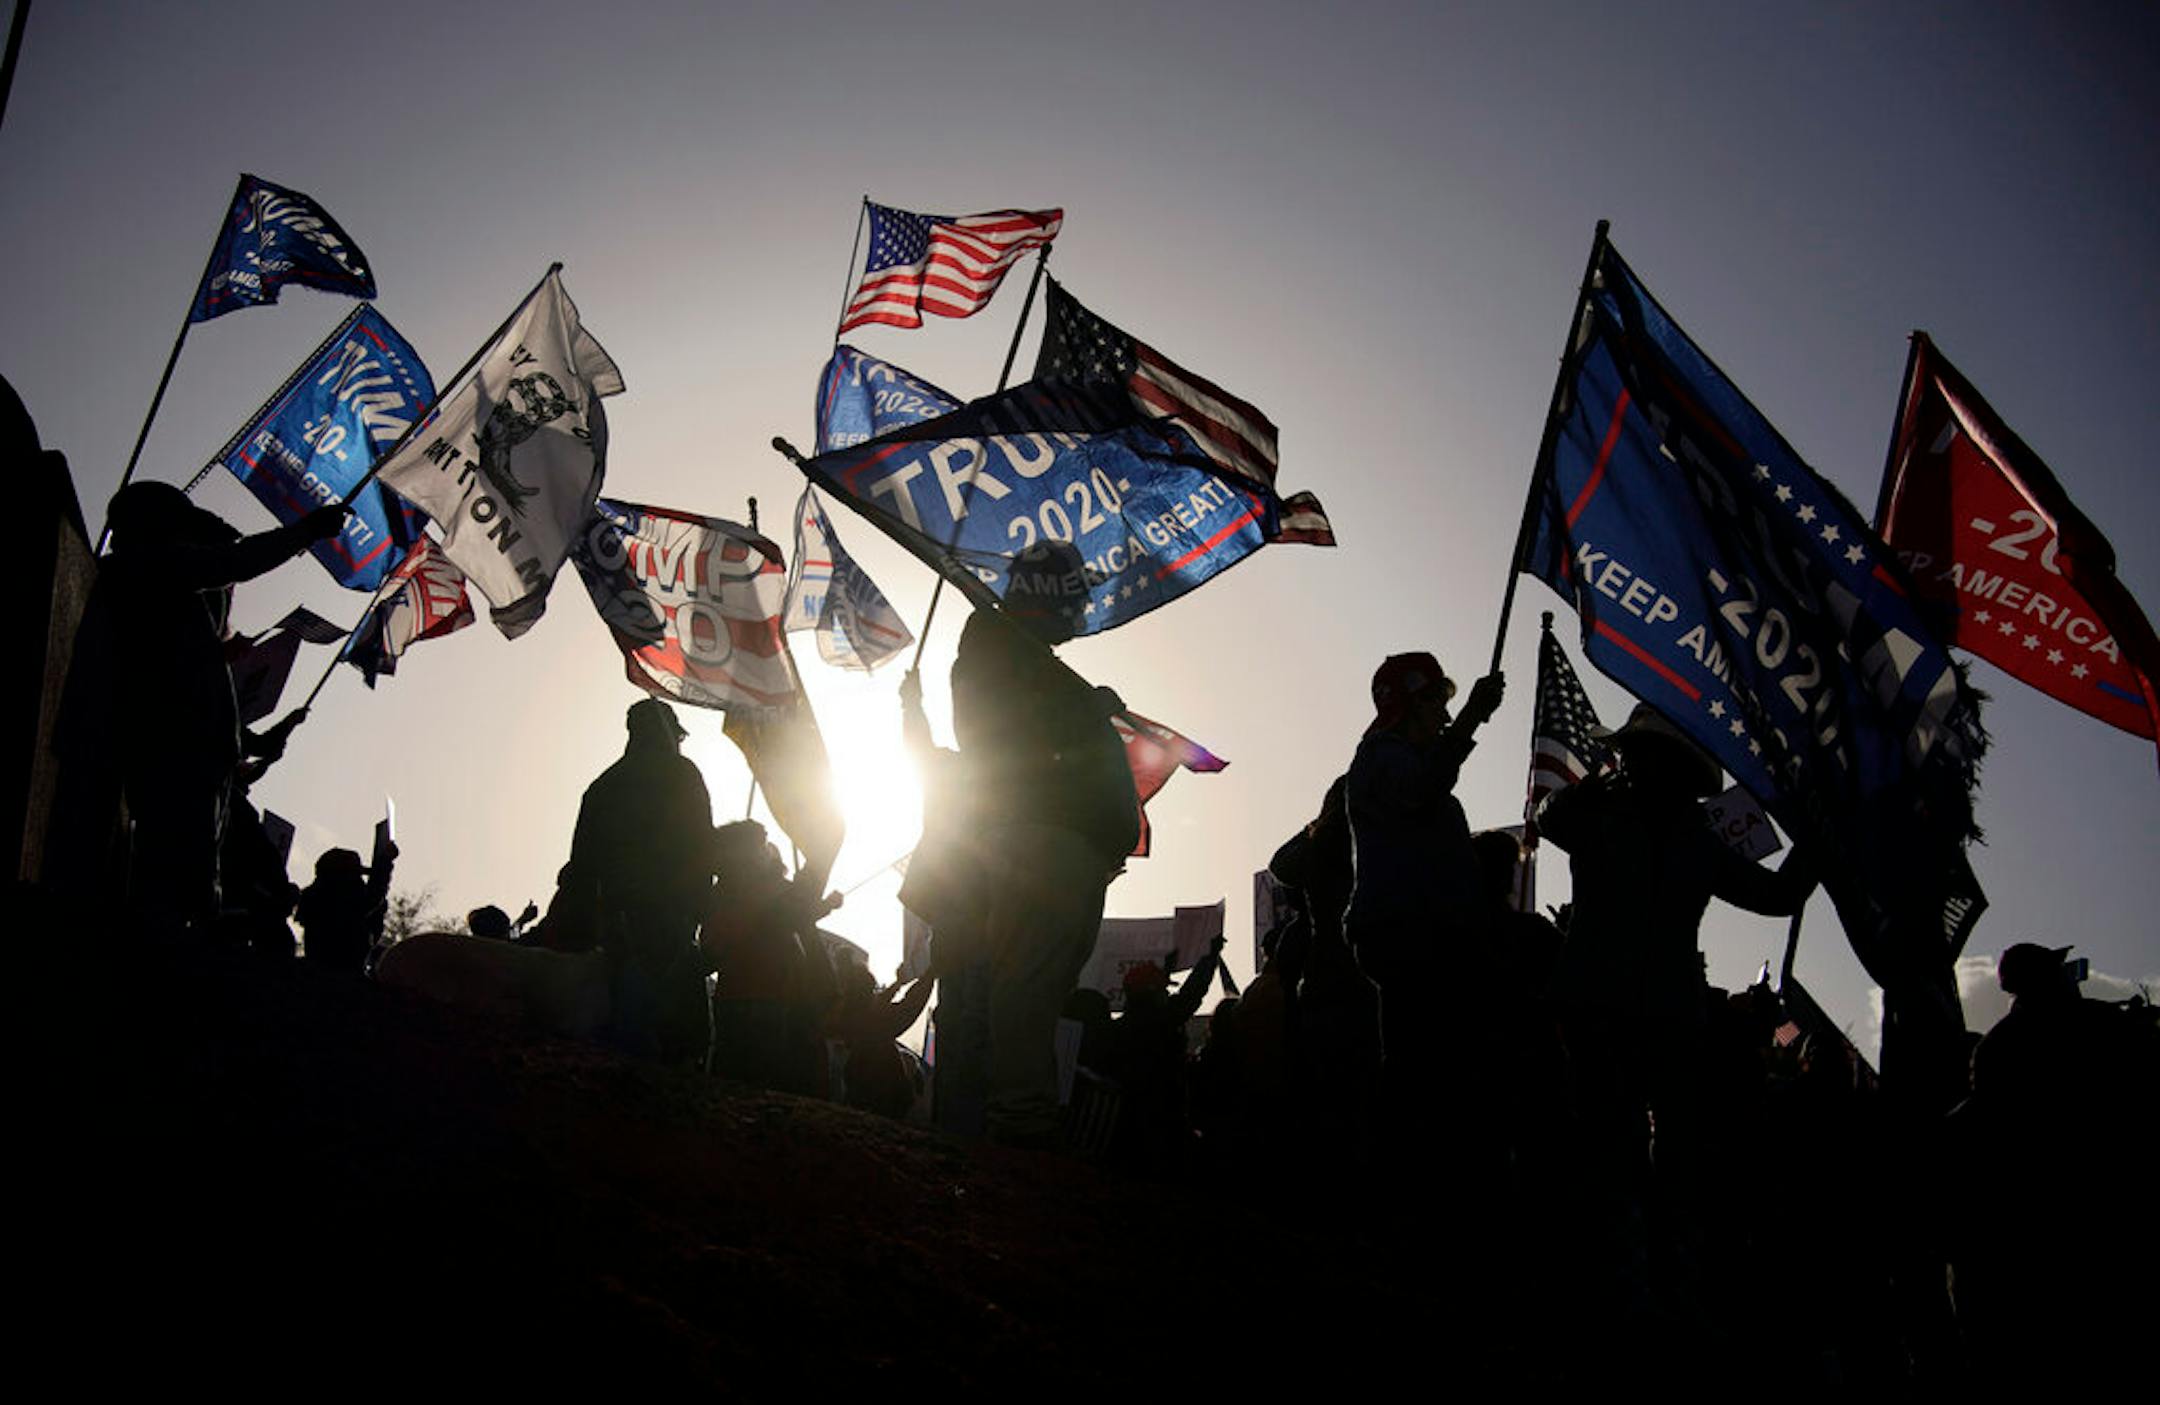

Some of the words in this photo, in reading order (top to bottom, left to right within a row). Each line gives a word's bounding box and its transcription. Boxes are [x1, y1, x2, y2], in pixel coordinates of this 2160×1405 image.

[1143, 476, 1236, 547] GREAT!
[1577, 541, 1680, 625] KEEP
[1935, 562, 2121, 666] AMERICA
